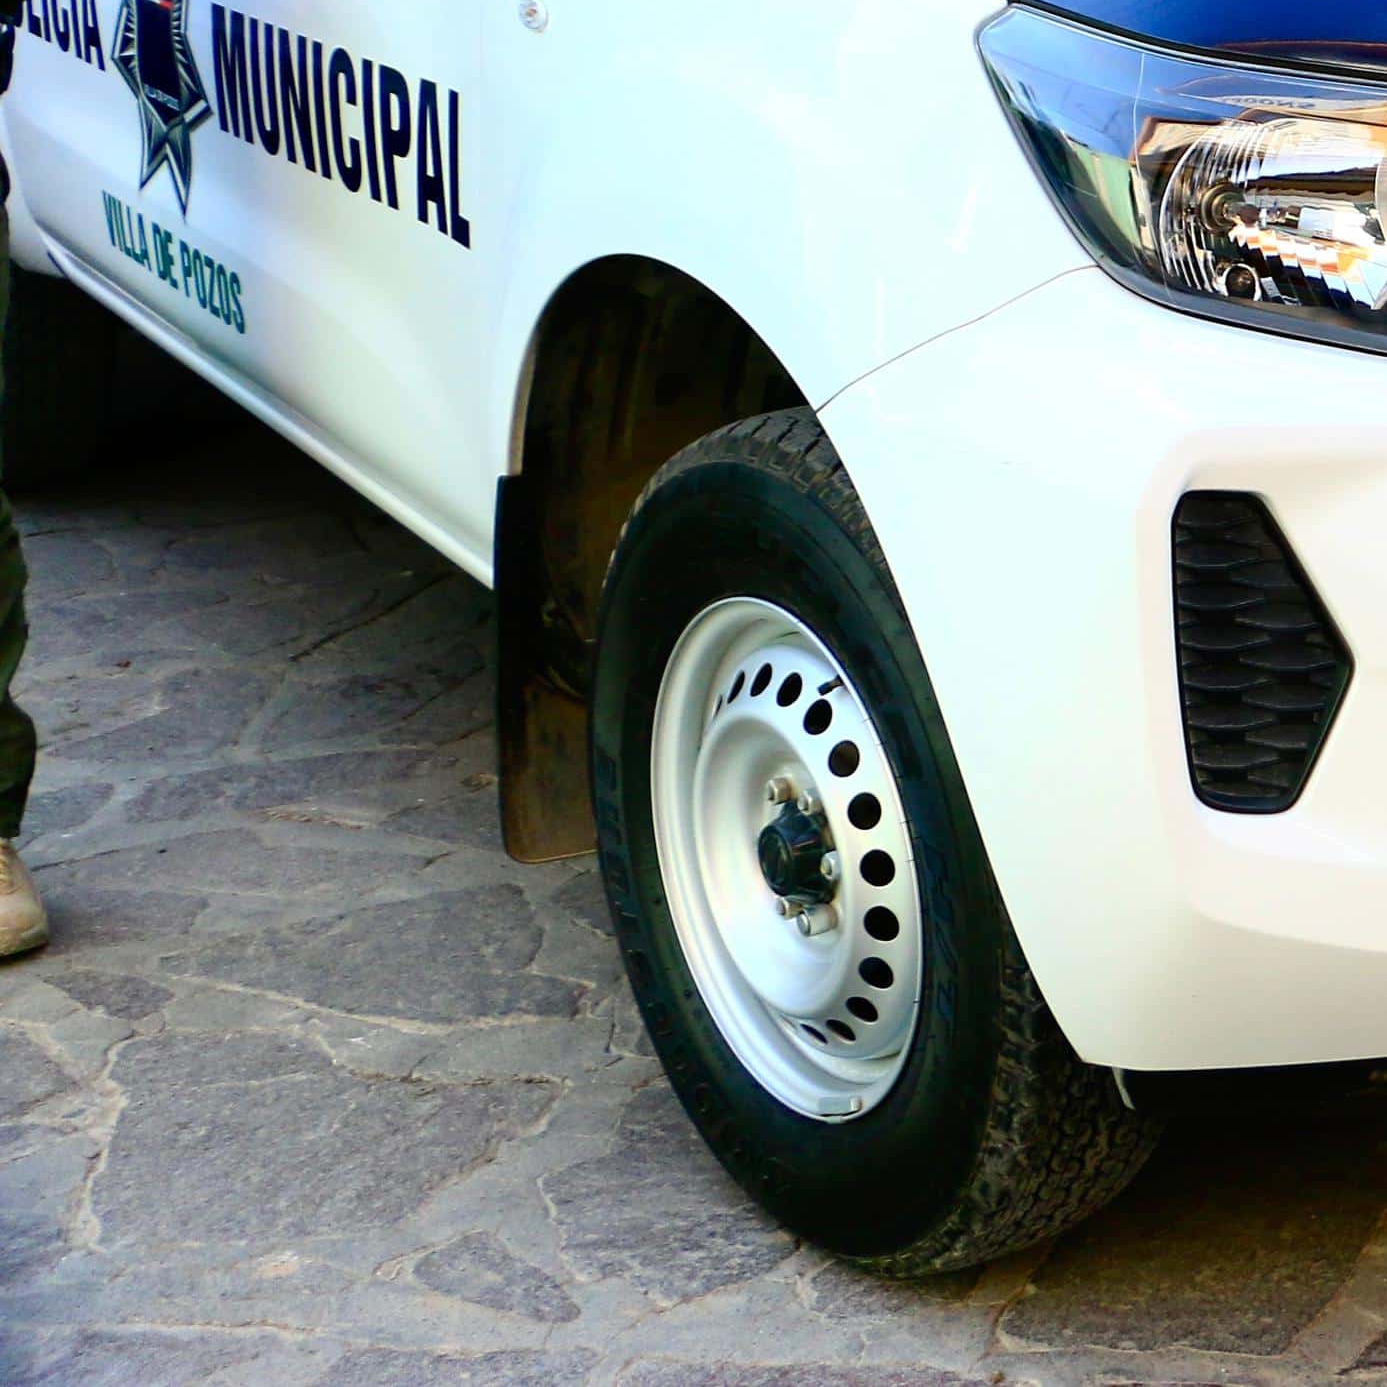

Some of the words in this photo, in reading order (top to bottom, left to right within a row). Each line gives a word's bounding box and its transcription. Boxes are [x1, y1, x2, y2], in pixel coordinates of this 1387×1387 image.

[211, 2, 471, 250] MUNICIPAL
[102, 189, 152, 273] VILLA
[152, 221, 179, 290] DE
[179, 239, 246, 334] POZOS
